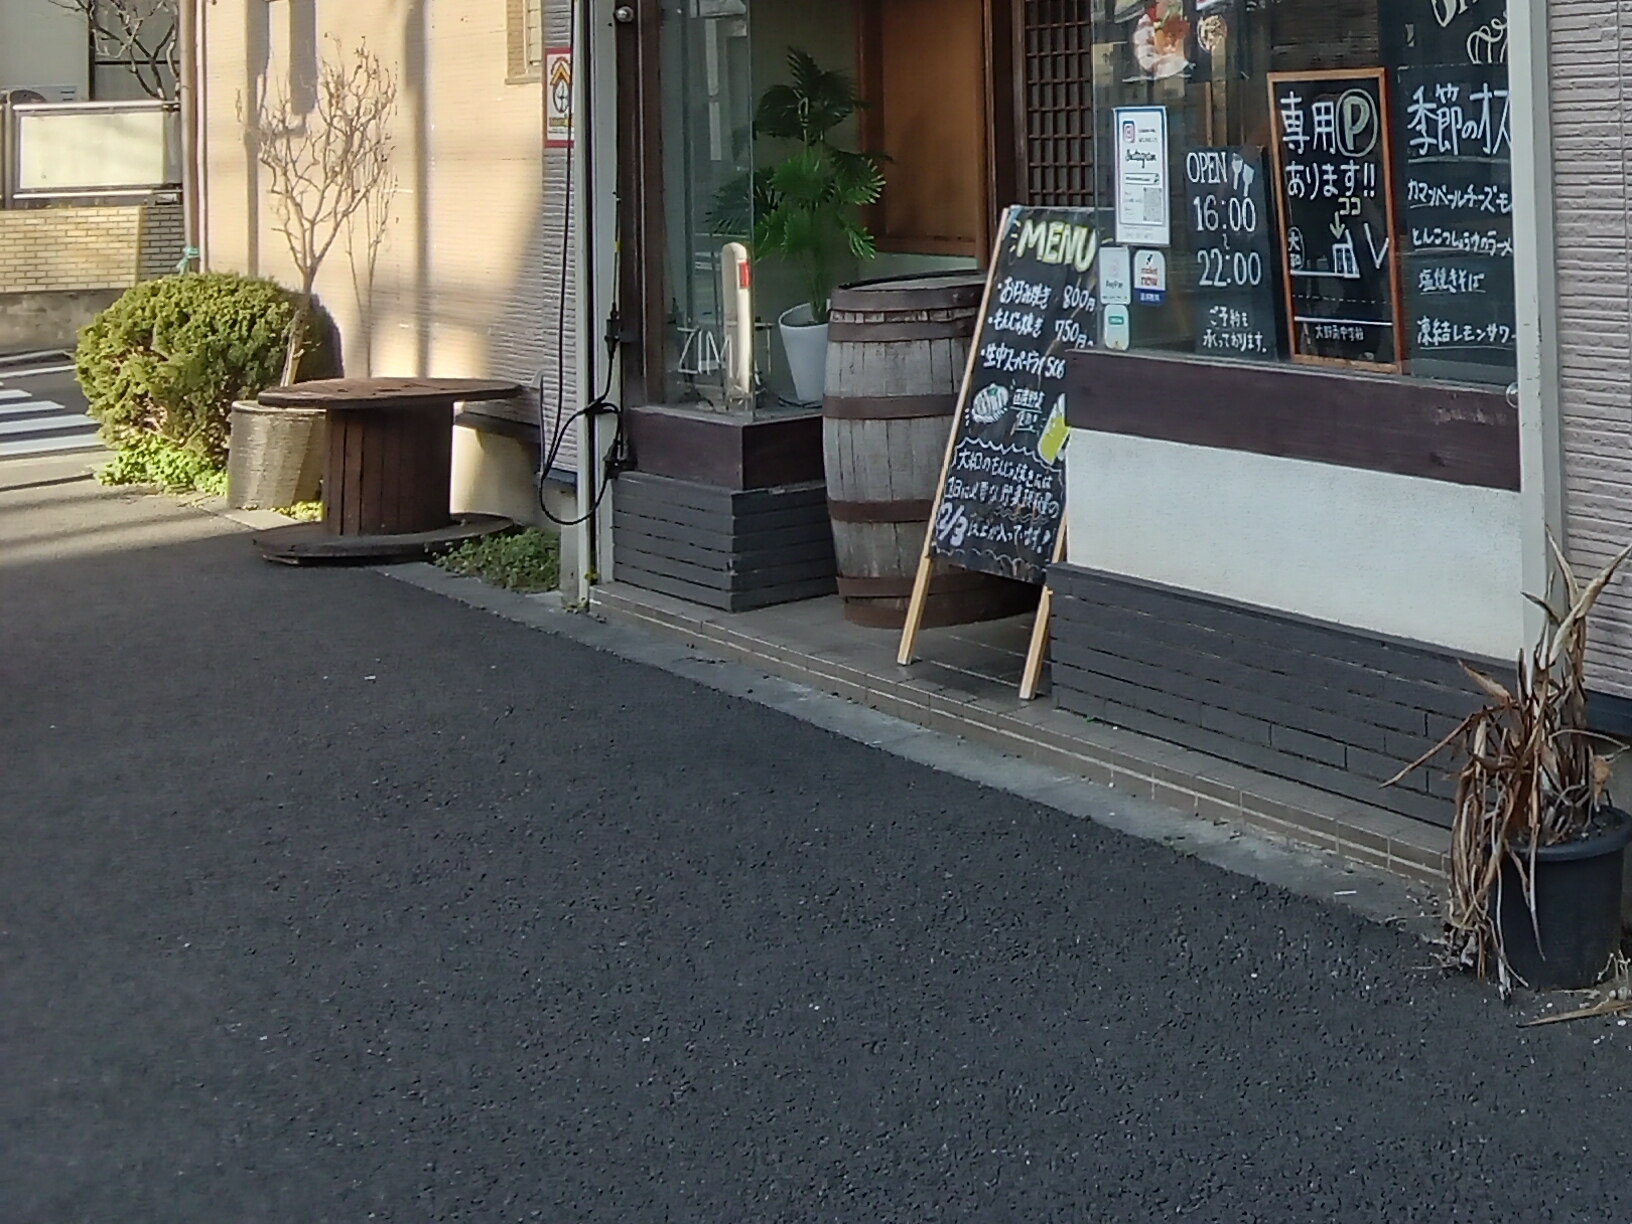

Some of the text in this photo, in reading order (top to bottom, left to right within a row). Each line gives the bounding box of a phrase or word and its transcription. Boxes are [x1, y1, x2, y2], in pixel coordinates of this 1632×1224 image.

[1186, 152, 1228, 184] OPEN
[1193, 194, 1256, 232] 16:00
[1338, 197, 1361, 215] ココ
[1017, 219, 1098, 273] MENU
[1197, 248, 1262, 287] 22:00
